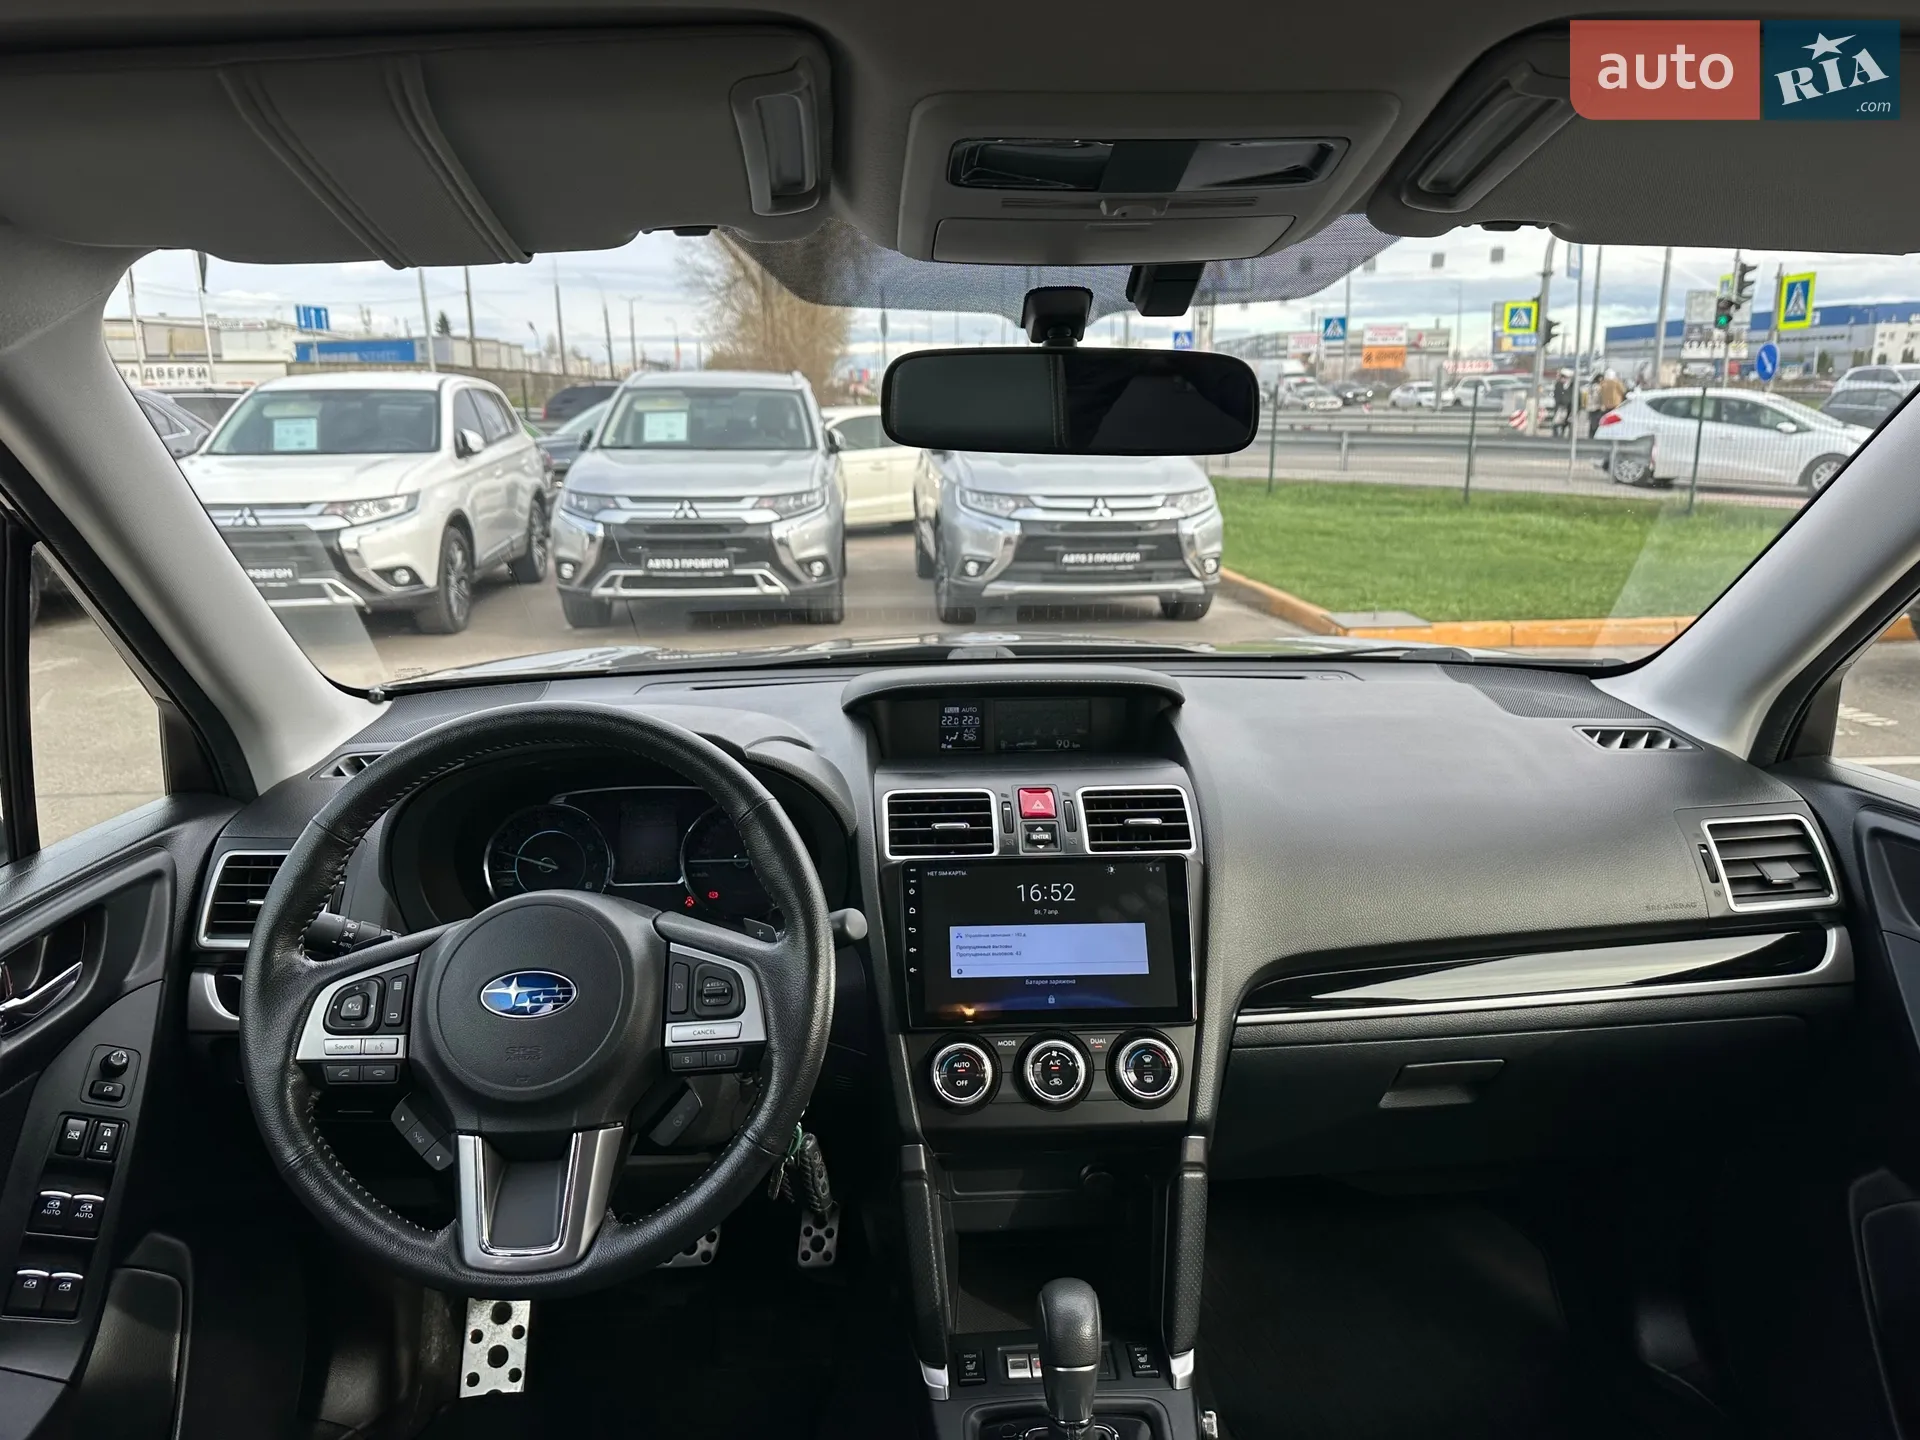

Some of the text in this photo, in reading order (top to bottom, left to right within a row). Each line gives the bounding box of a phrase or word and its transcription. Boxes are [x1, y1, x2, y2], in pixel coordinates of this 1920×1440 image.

[144, 366, 208, 380] ДВЕРЕЙ
[1056, 739, 1070, 749] 90
[1016, 882, 1076, 902] 16:52
[41, 1208, 61, 1216] AUTO
